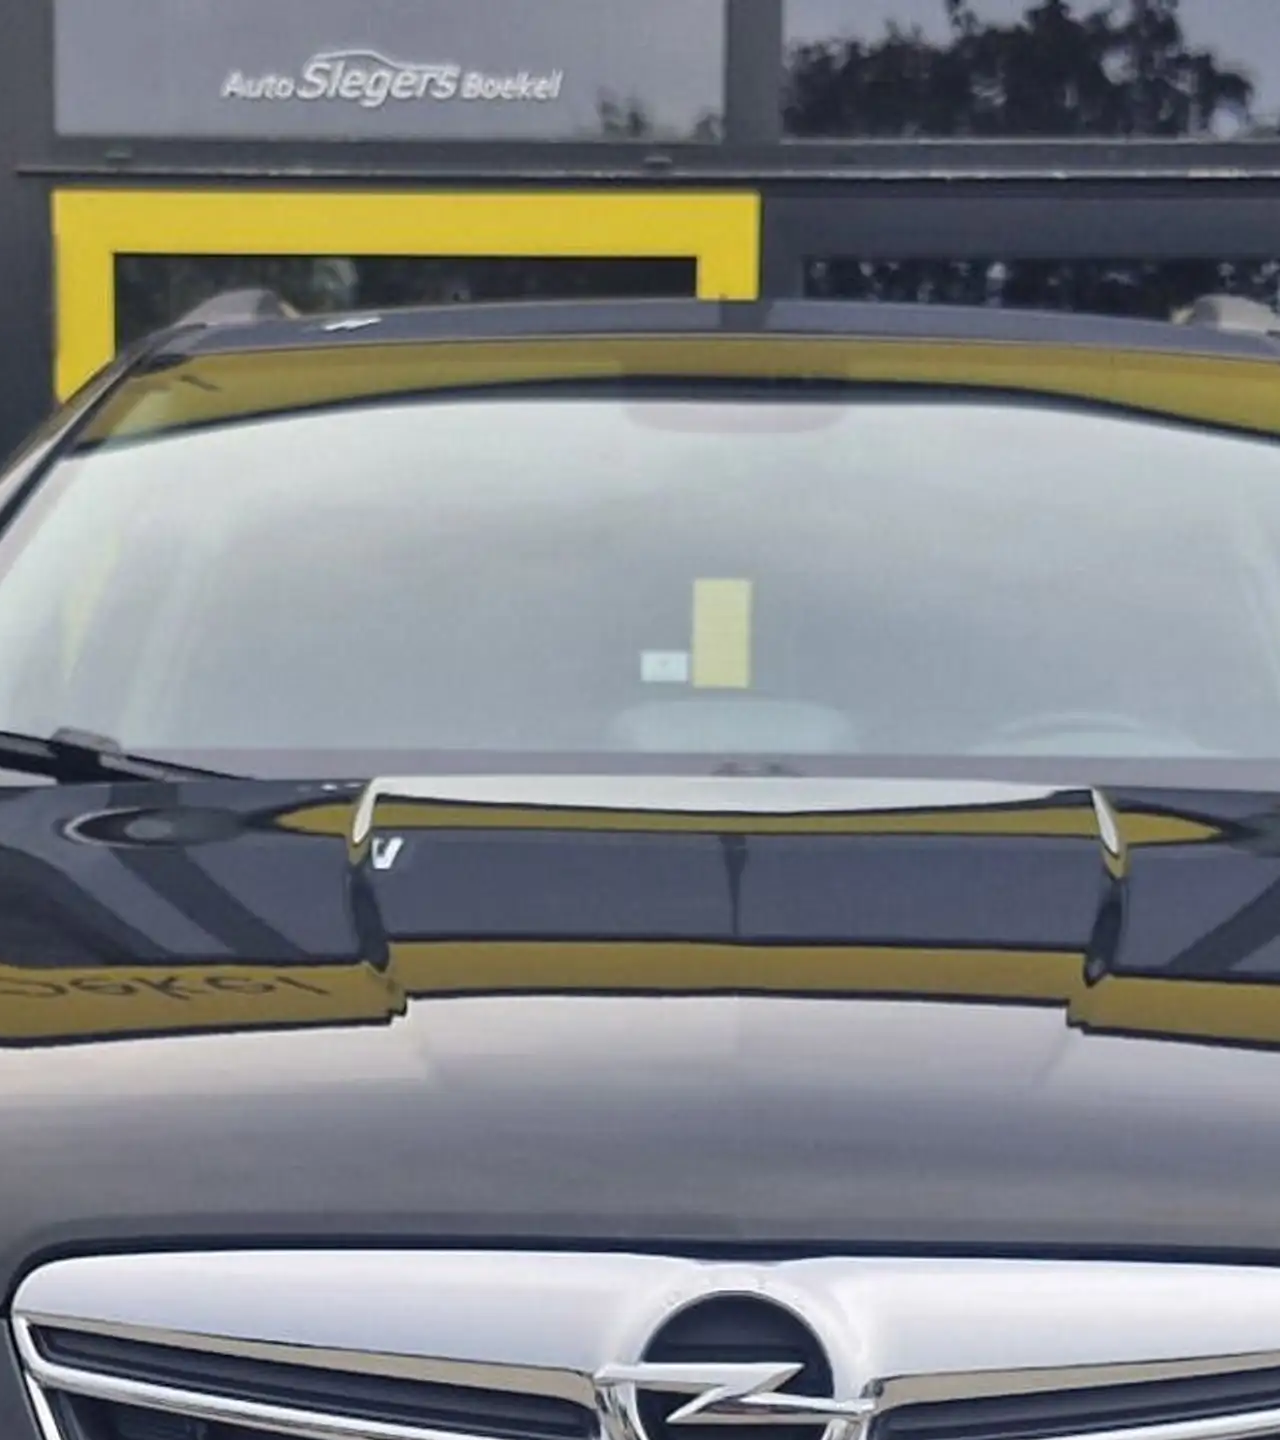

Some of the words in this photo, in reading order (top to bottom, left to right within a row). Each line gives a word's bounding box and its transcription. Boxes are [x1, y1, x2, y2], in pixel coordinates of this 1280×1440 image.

[222, 69, 295, 98] Auto
[296, 57, 461, 107] Slegers
[462, 68, 563, 99] Boekel
